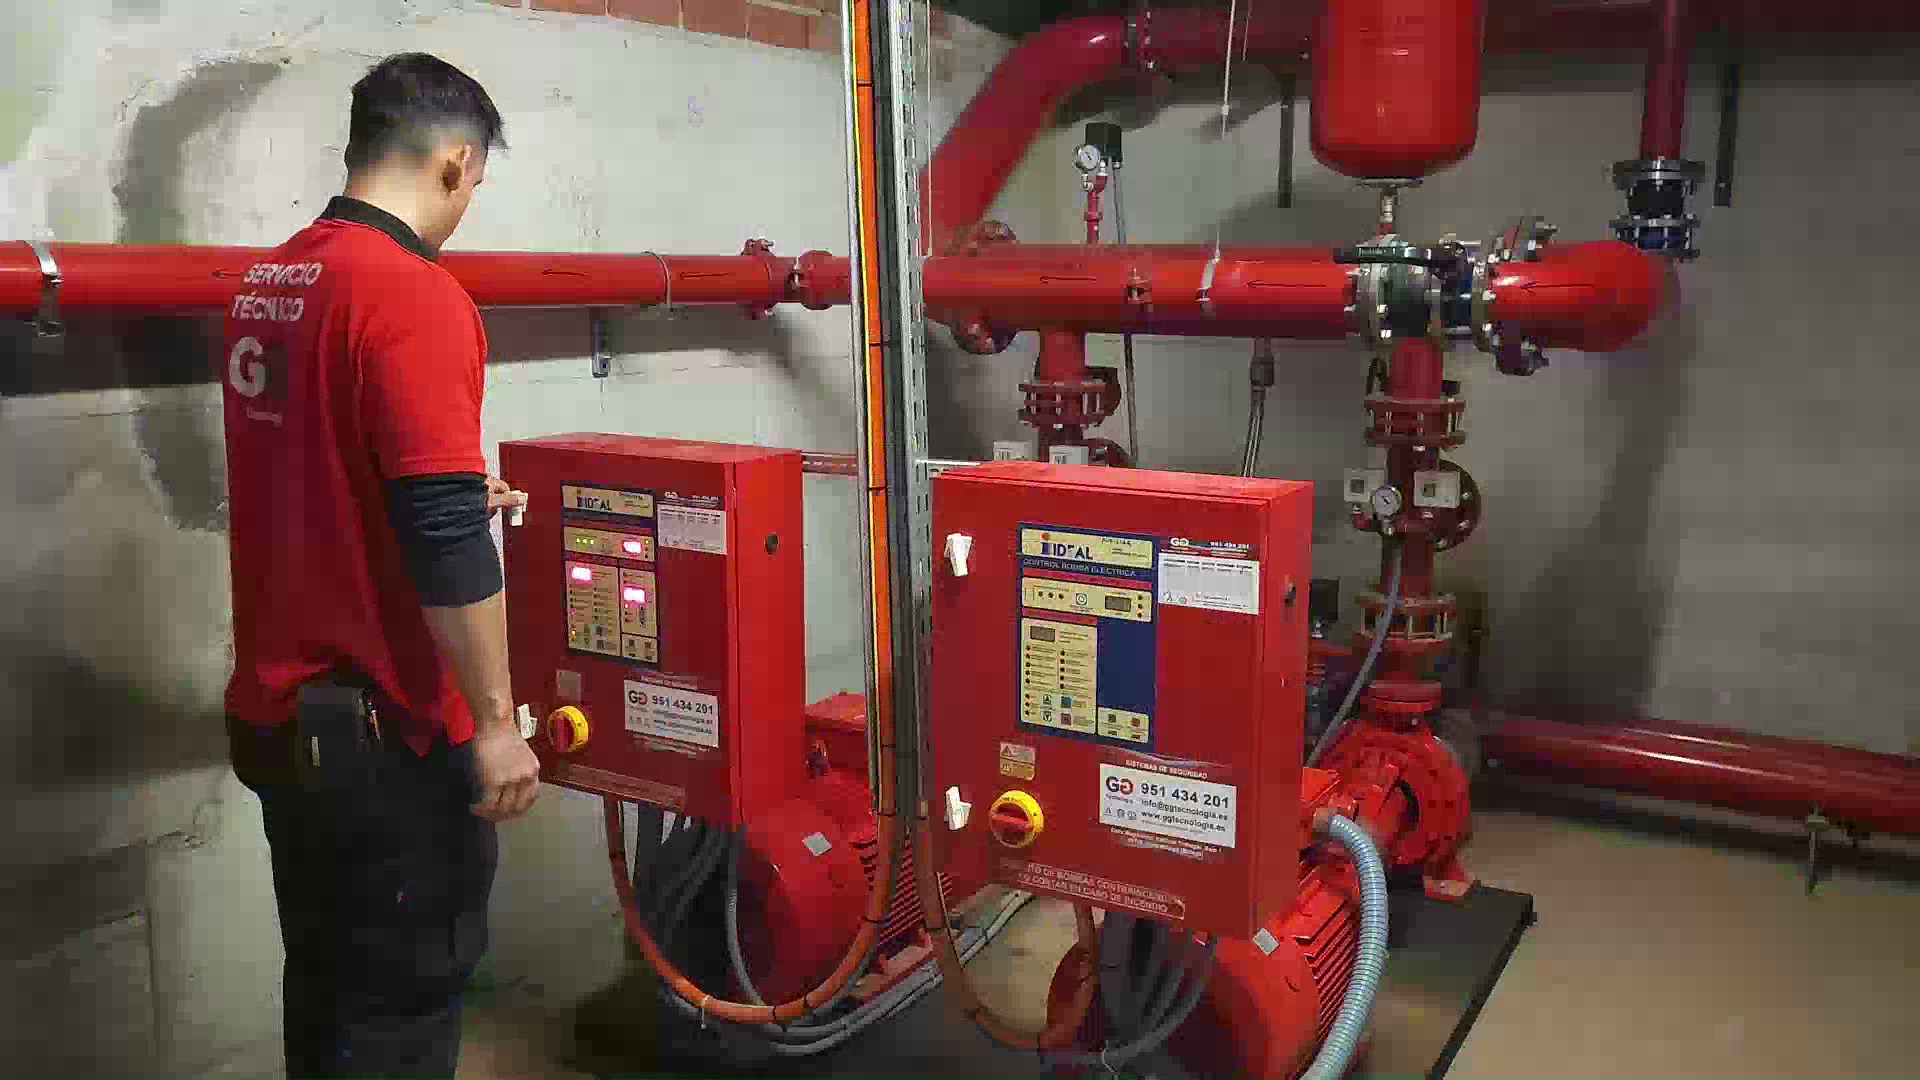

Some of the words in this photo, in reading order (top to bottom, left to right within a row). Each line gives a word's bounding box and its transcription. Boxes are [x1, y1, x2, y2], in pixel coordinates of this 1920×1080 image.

[243, 262, 323, 287] SERVICIO
[231, 291, 304, 322] TÉCNICO
[1023, 558, 1061, 568] CONTROL
[652, 695, 670, 708] 951
[672, 700, 693, 712] 434
[695, 703, 713, 715] 201
[1140, 783, 1166, 798] 951
[1171, 788, 1199, 803] 434
[1203, 794, 1229, 808] 201
